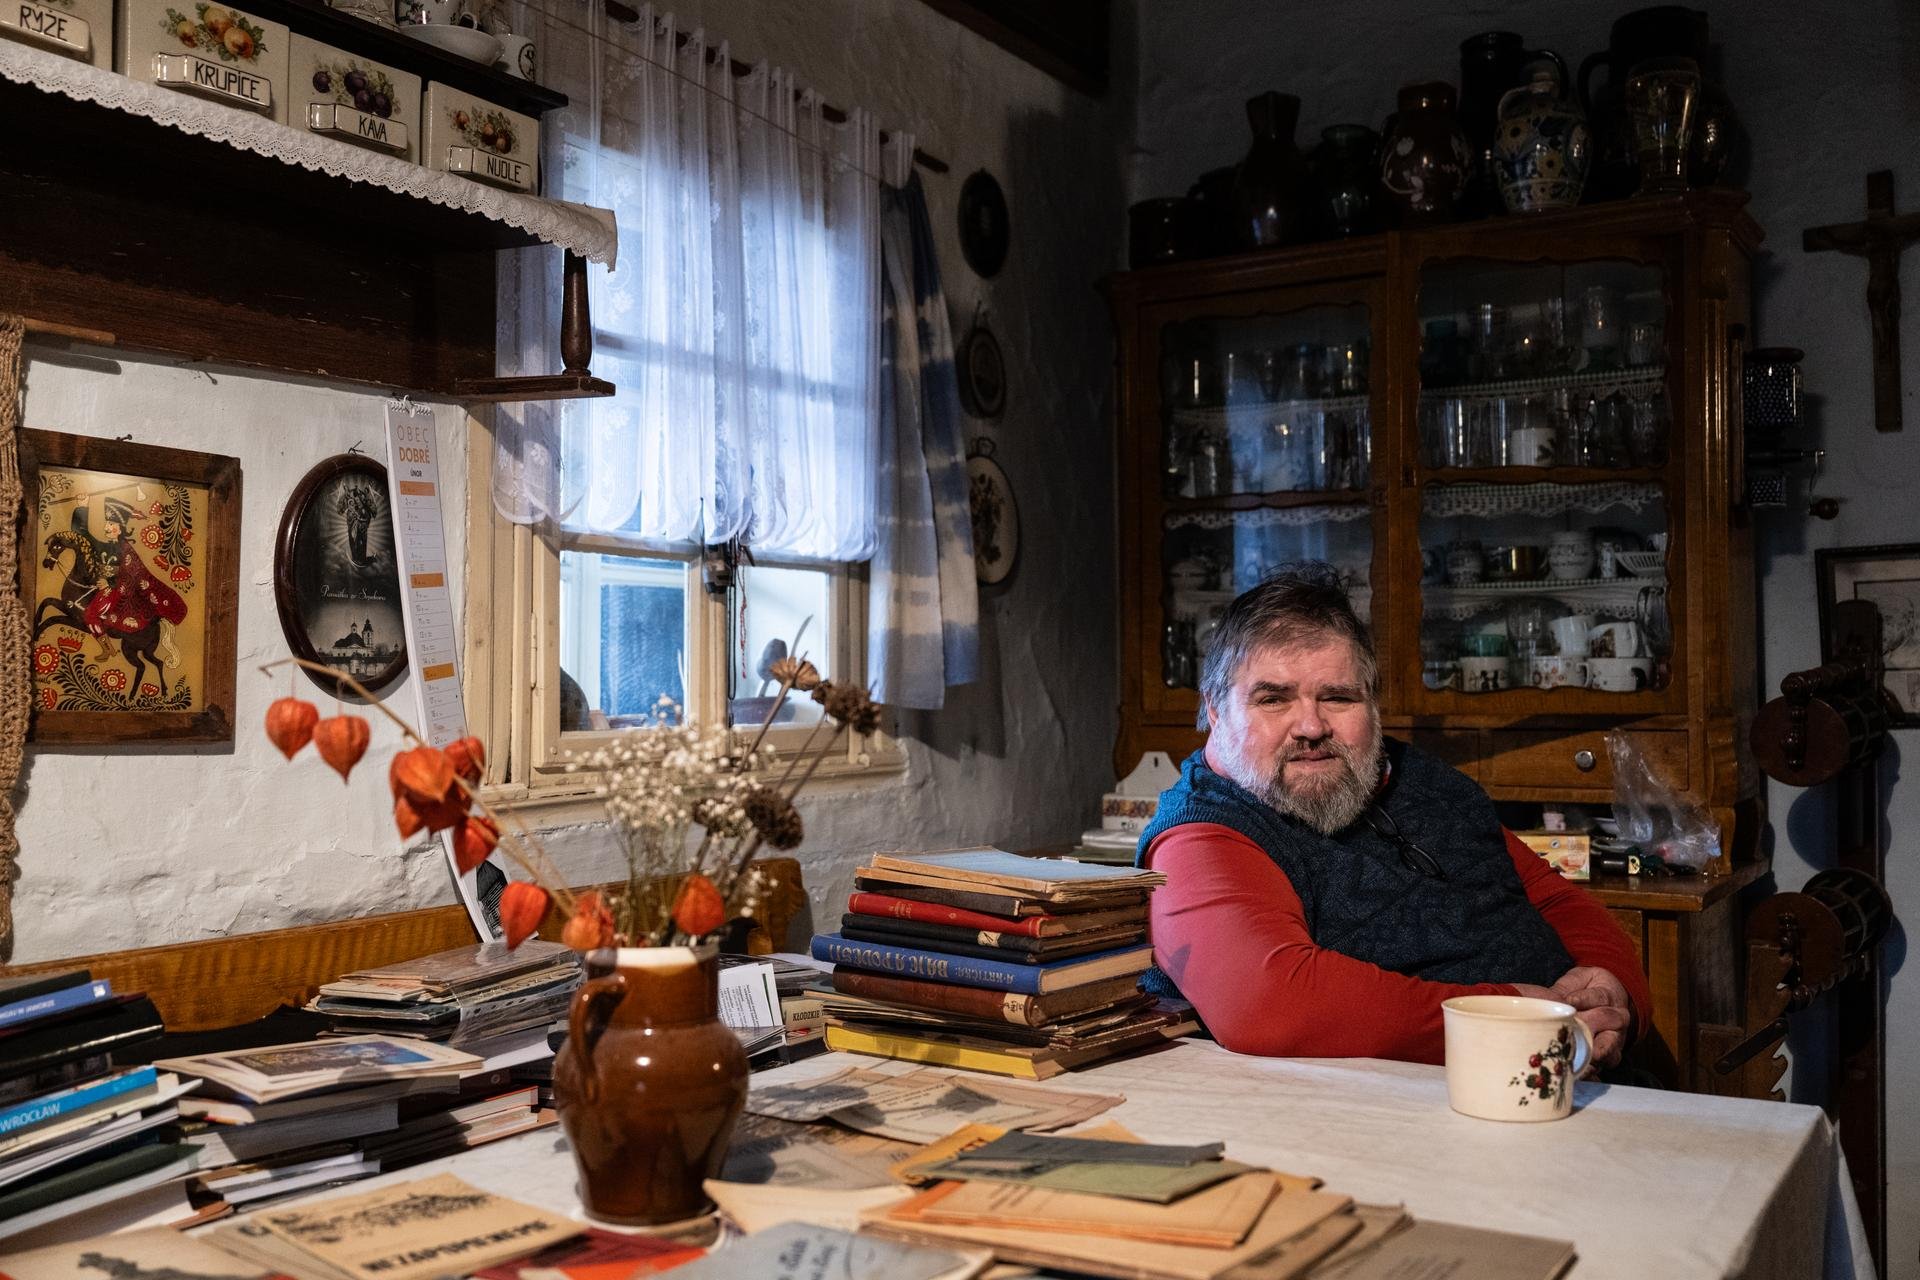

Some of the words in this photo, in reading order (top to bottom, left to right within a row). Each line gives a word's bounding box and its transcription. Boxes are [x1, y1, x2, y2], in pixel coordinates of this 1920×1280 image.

[487, 155, 522, 183] NUDLE
[397, 424, 429, 443] OBEC
[399, 444, 431, 464] DOBRÉ
[0, 1102, 60, 1132] WROCŁAW
